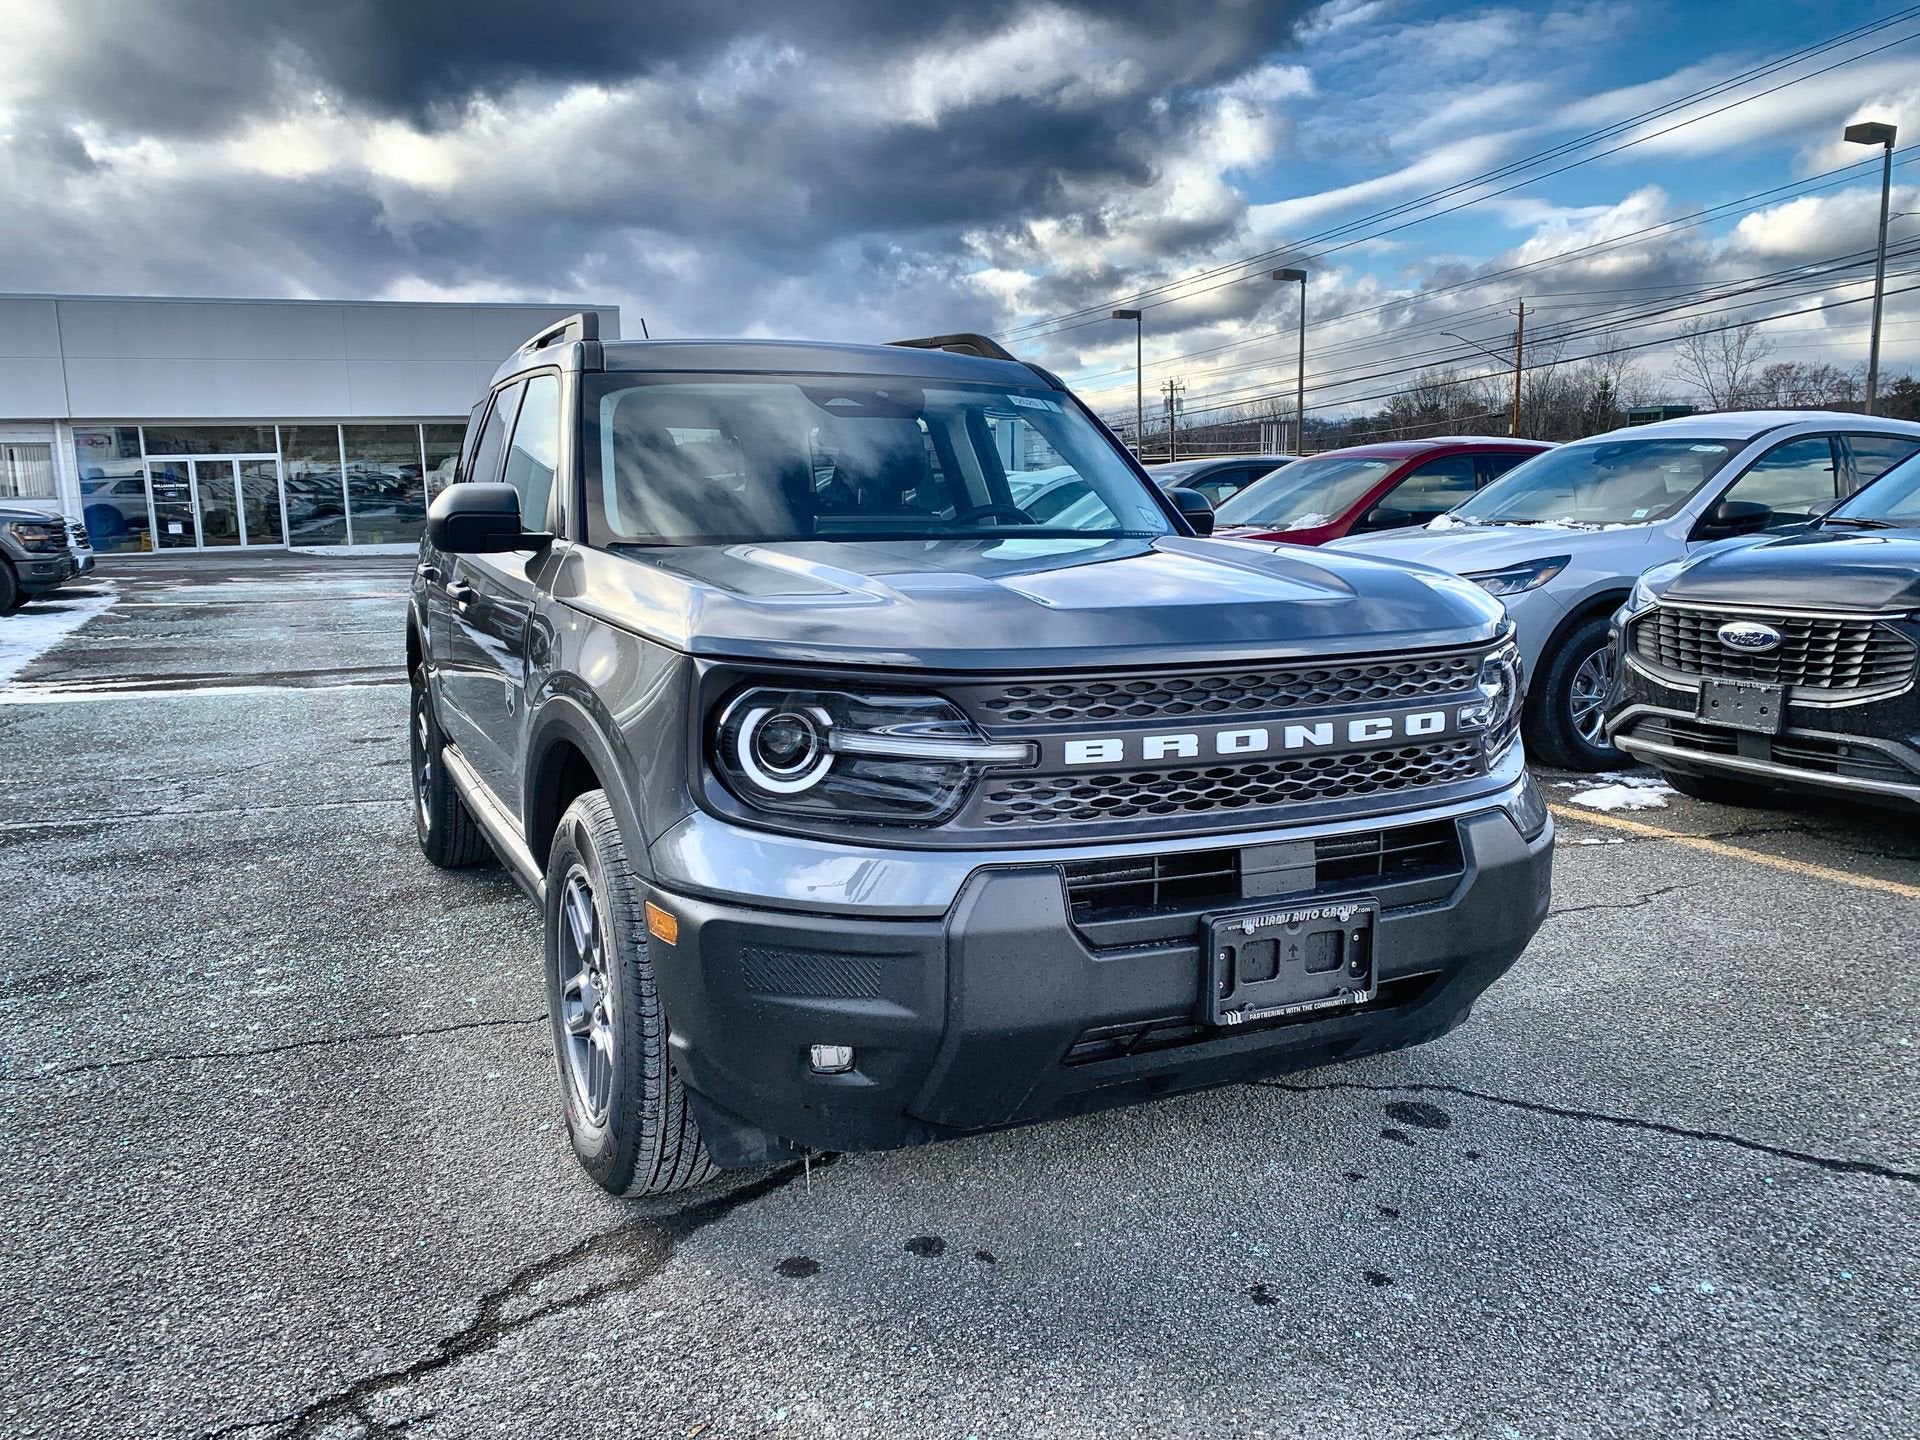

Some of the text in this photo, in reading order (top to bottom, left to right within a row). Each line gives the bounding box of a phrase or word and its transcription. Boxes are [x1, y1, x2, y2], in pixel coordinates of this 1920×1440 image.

[1064, 711, 1446, 765] BRONCO
[1291, 909, 1320, 922] AUTO
[1249, 998, 1347, 1020] PARTNERING WITH THE COMMUNITY
